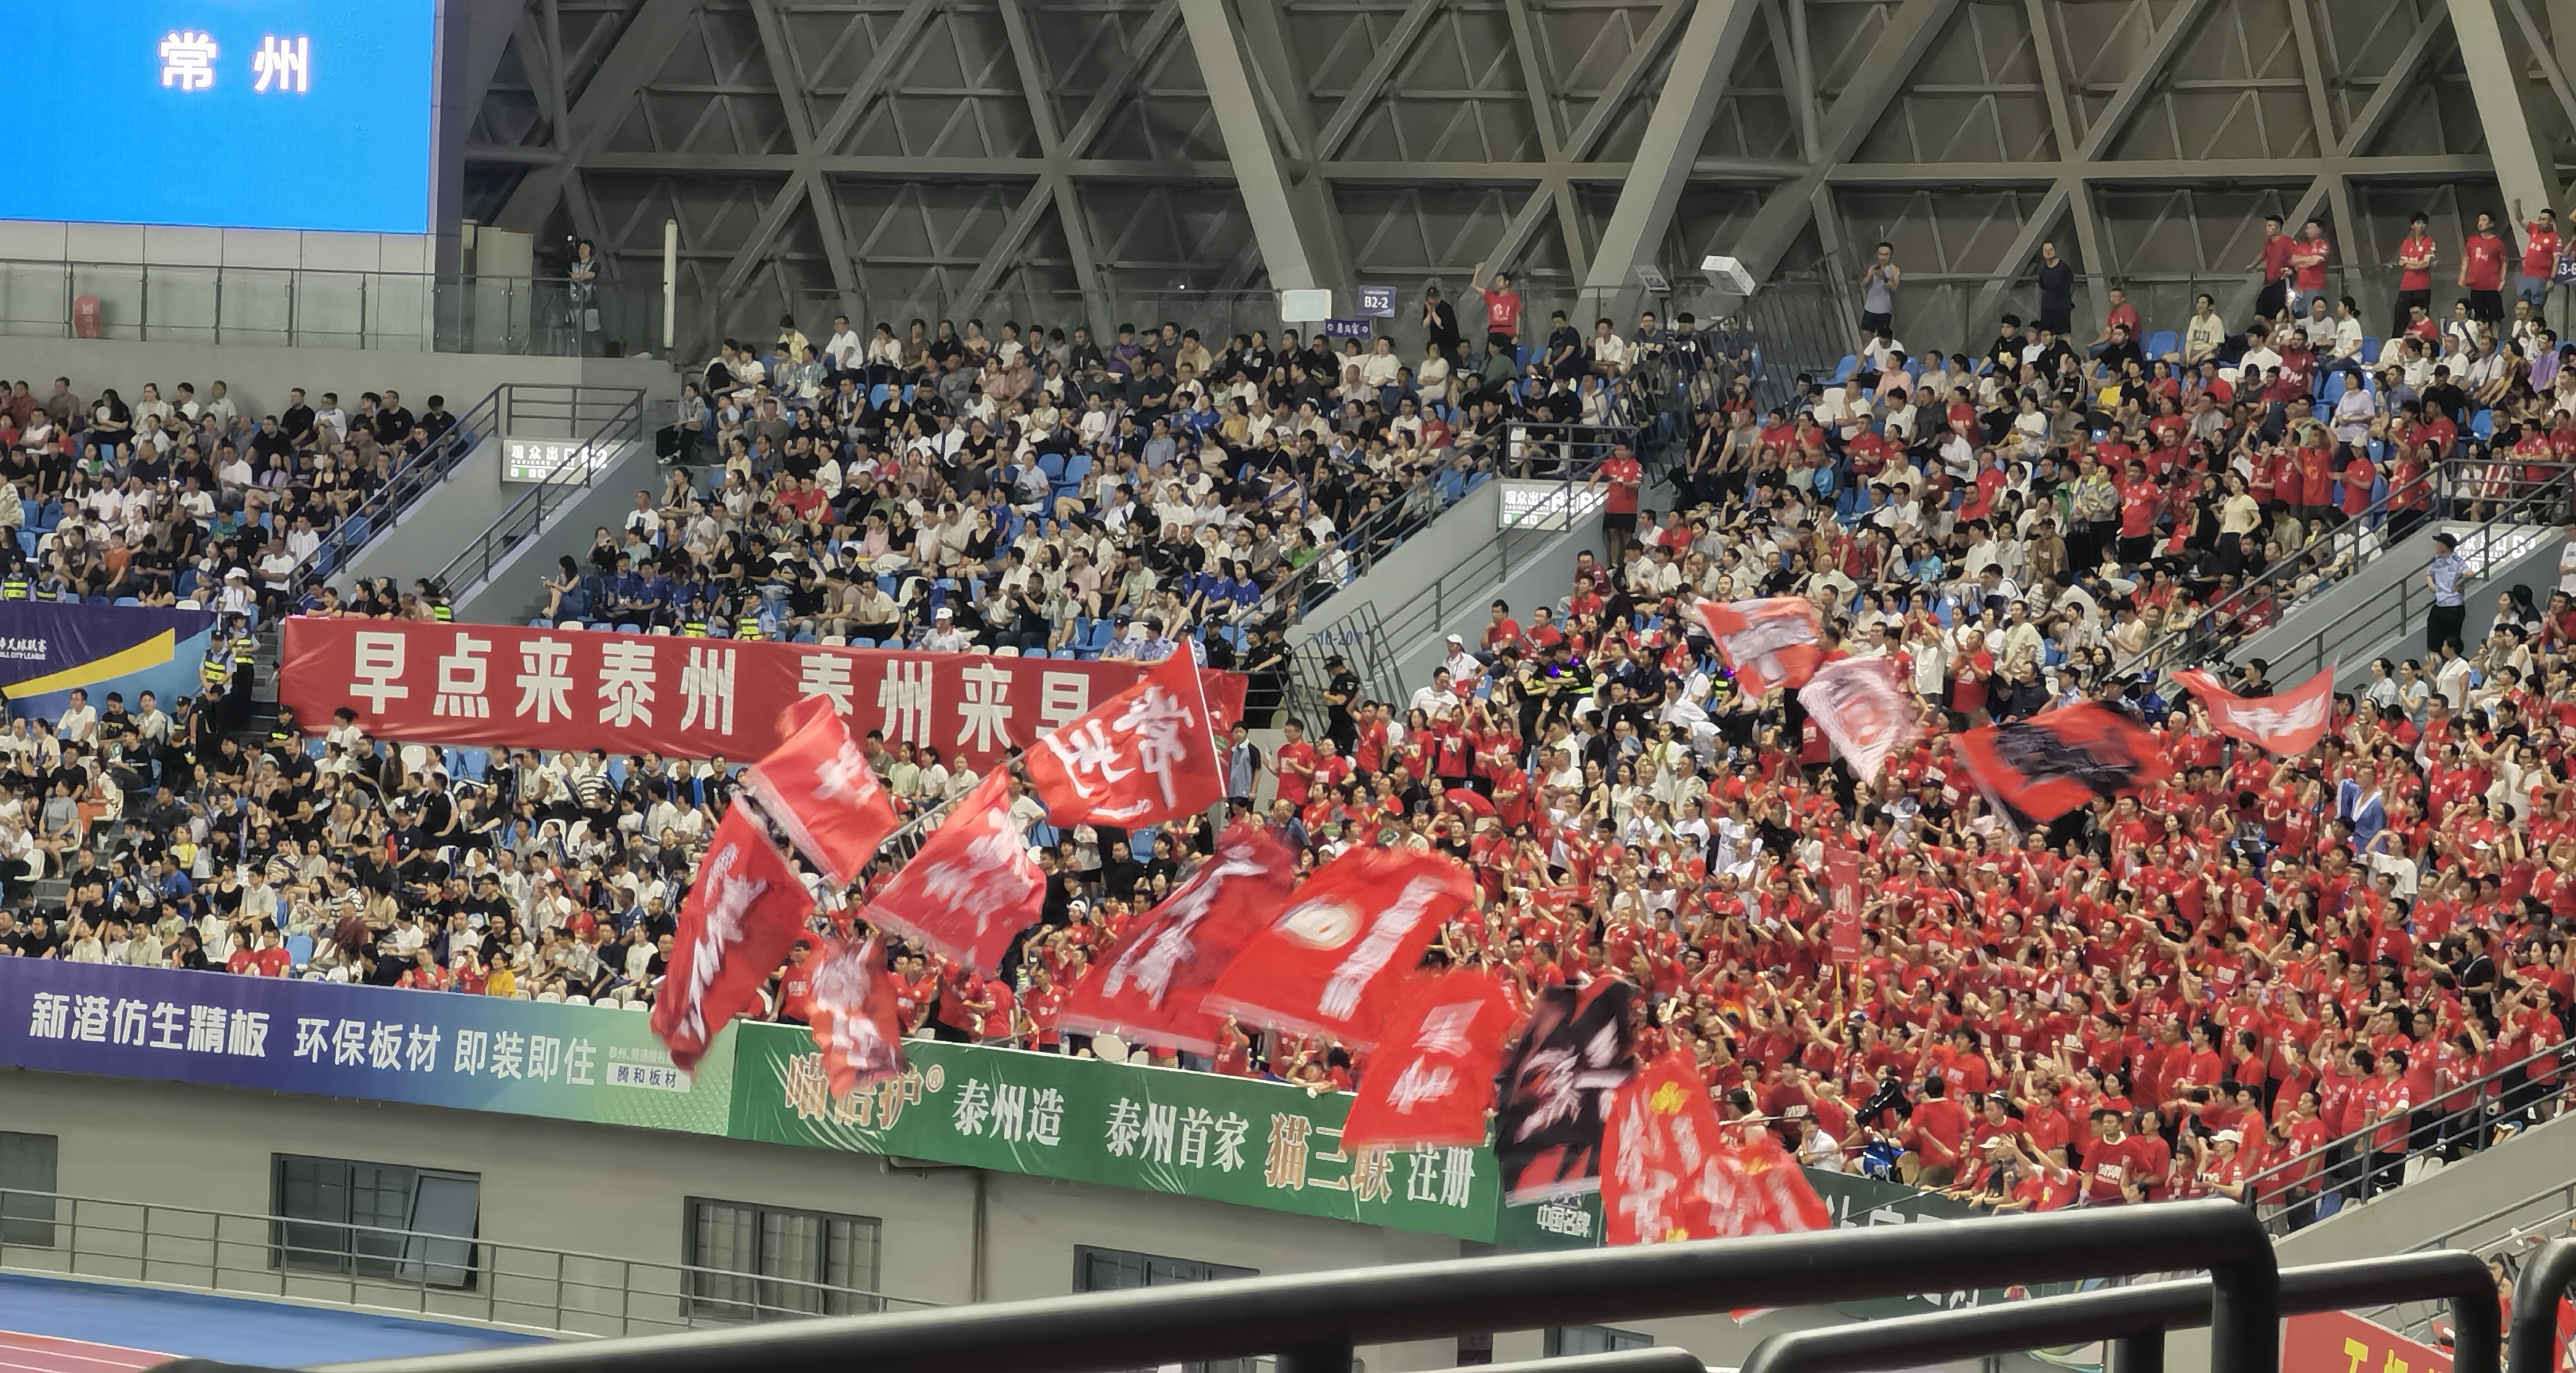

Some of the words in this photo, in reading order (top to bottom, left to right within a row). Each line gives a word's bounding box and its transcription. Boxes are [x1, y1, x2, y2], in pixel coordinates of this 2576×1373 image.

[159, 31, 309, 92] 常州
[349, 630, 736, 736] 早点来泰州
[798, 653, 1148, 753] 泰州来早
[29, 992, 270, 1058] 新港仿生精板
[293, 1017, 441, 1073] 环保板材
[454, 1029, 597, 1086] 即装即住
[951, 1077, 1065, 1147] 泰州造
[1104, 1097, 1250, 1173] 泰州首家
[1263, 1111, 1395, 1204] 猫三联
[1407, 1142, 1476, 1209] 注册
